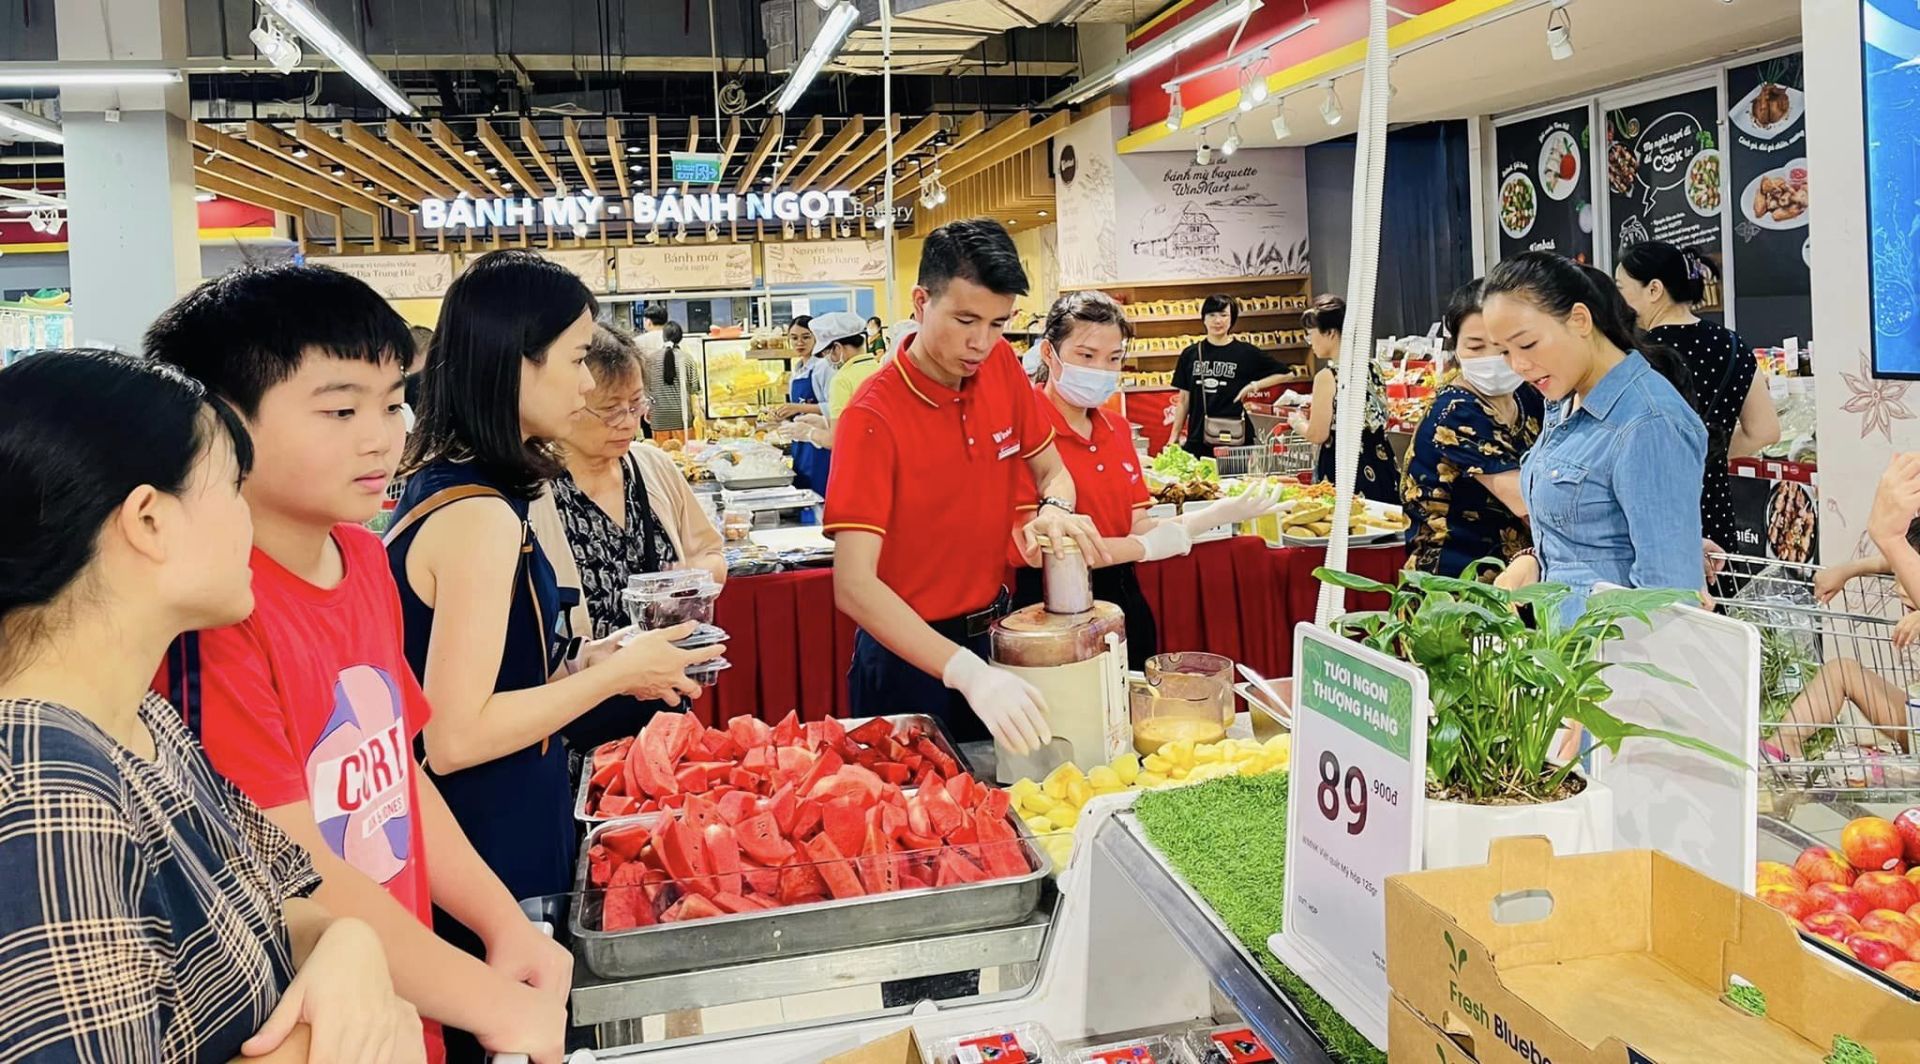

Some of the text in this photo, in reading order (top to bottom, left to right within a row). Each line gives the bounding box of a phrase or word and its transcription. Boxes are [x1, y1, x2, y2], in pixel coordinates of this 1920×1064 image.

[1211, 166, 1258, 182] baguette
[1653, 150, 1684, 172] COOK
[1172, 181, 1230, 196] WinMart
[421, 191, 534, 229] BÁNH
[543, 188, 604, 226] MỲ
[632, 187, 738, 224] BÁNH
[746, 190, 851, 227] NGỌT
[663, 251, 693, 264] Bánh
[1192, 360, 1238, 379] BLUE
[1323, 660, 1388, 704] TƯƠI NGON
[1312, 679, 1399, 737] THƯỢNG HẠNG
[1317, 750, 1368, 835] 89
[1449, 979, 1490, 1030] Fresh
